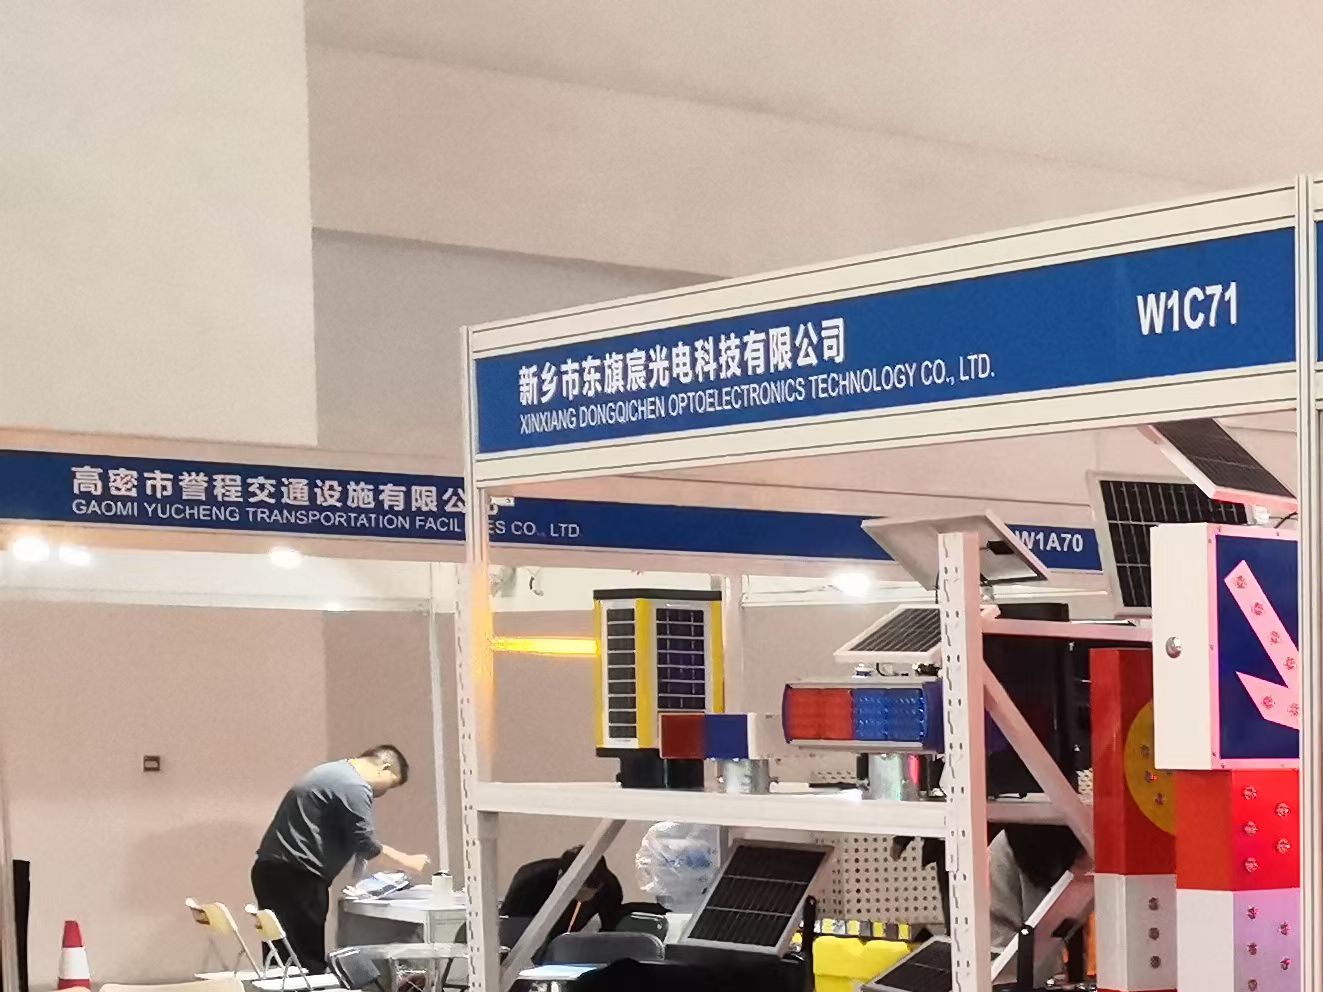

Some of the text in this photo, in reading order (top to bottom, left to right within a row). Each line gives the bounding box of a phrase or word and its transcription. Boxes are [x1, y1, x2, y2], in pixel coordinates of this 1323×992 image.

[1136, 281, 1237, 336] W1C71
[518, 317, 845, 406] 新乡市东旗宸光电科技有限公司
[520, 407, 577, 435] XINXIANG
[579, 395, 665, 427] DONGQICHEN
[668, 376, 806, 415] OPTOELECTRONICS
[808, 361, 917, 399] TECHNOLOGY
[959, 352, 996, 382] LTD.
[72, 498, 138, 518] GAOMI
[144, 504, 240, 522] YUCHENG
[245, 507, 409, 531] TRANSPORTATION
[1014, 529, 1084, 552] W1A70
